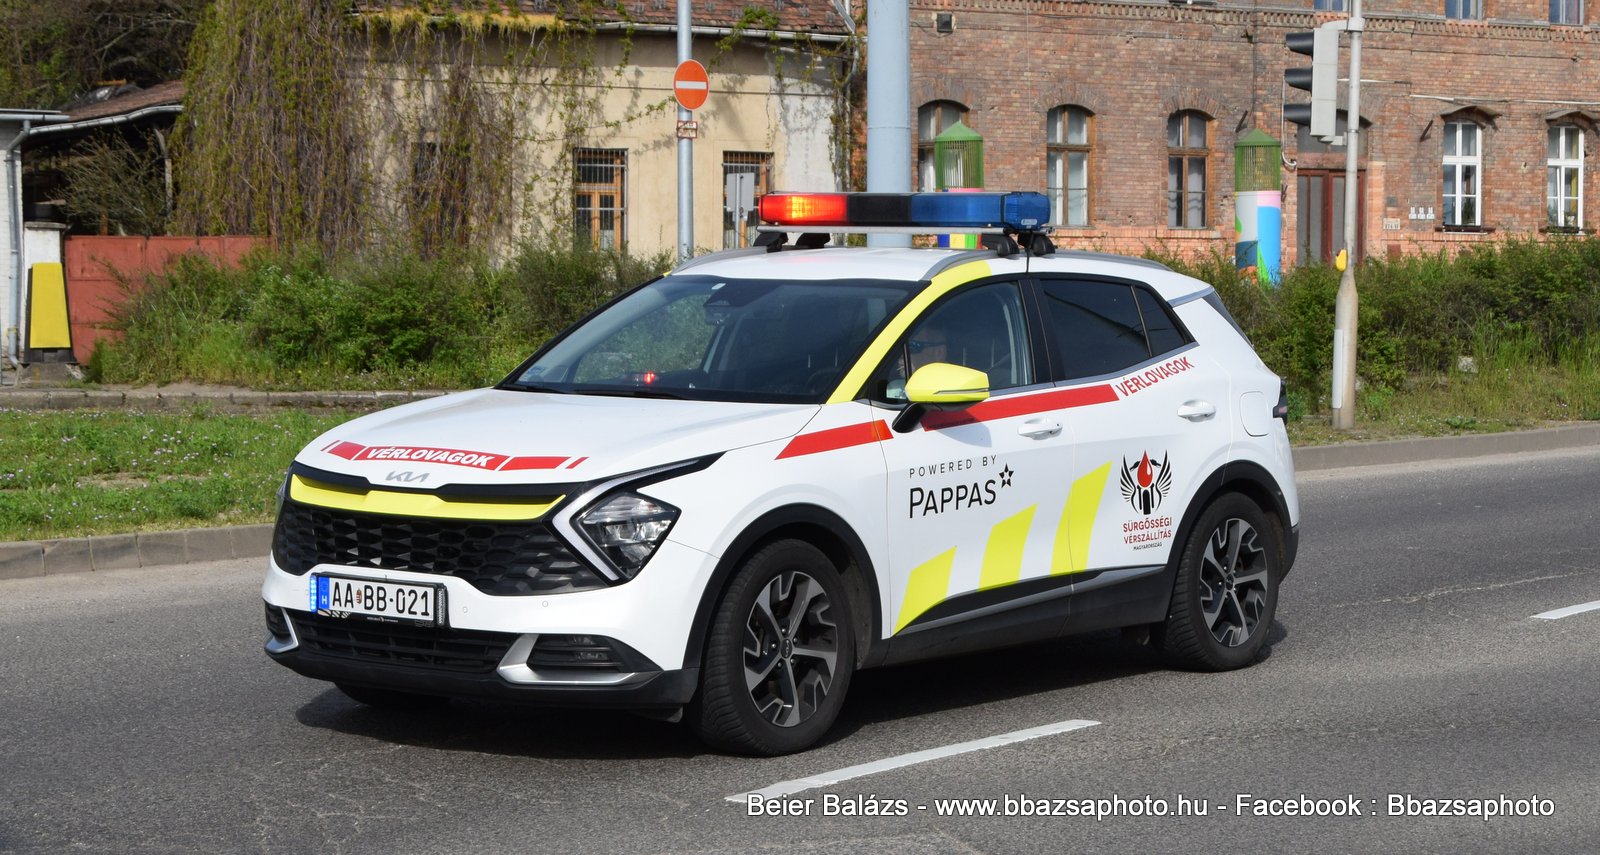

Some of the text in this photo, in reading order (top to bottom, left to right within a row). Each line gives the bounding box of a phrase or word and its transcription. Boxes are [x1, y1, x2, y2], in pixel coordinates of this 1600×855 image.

[1115, 356, 1195, 397] VÉRLOVAGOK
[367, 445, 495, 468] VÉRLOVAGOK
[909, 454, 997, 478] POWERED BY
[1122, 516, 1172, 533] SÜRGŐSSÉGI
[1123, 528, 1172, 544] VÉRSZÁLLÍTÁS
[321, 596, 328, 605] H
